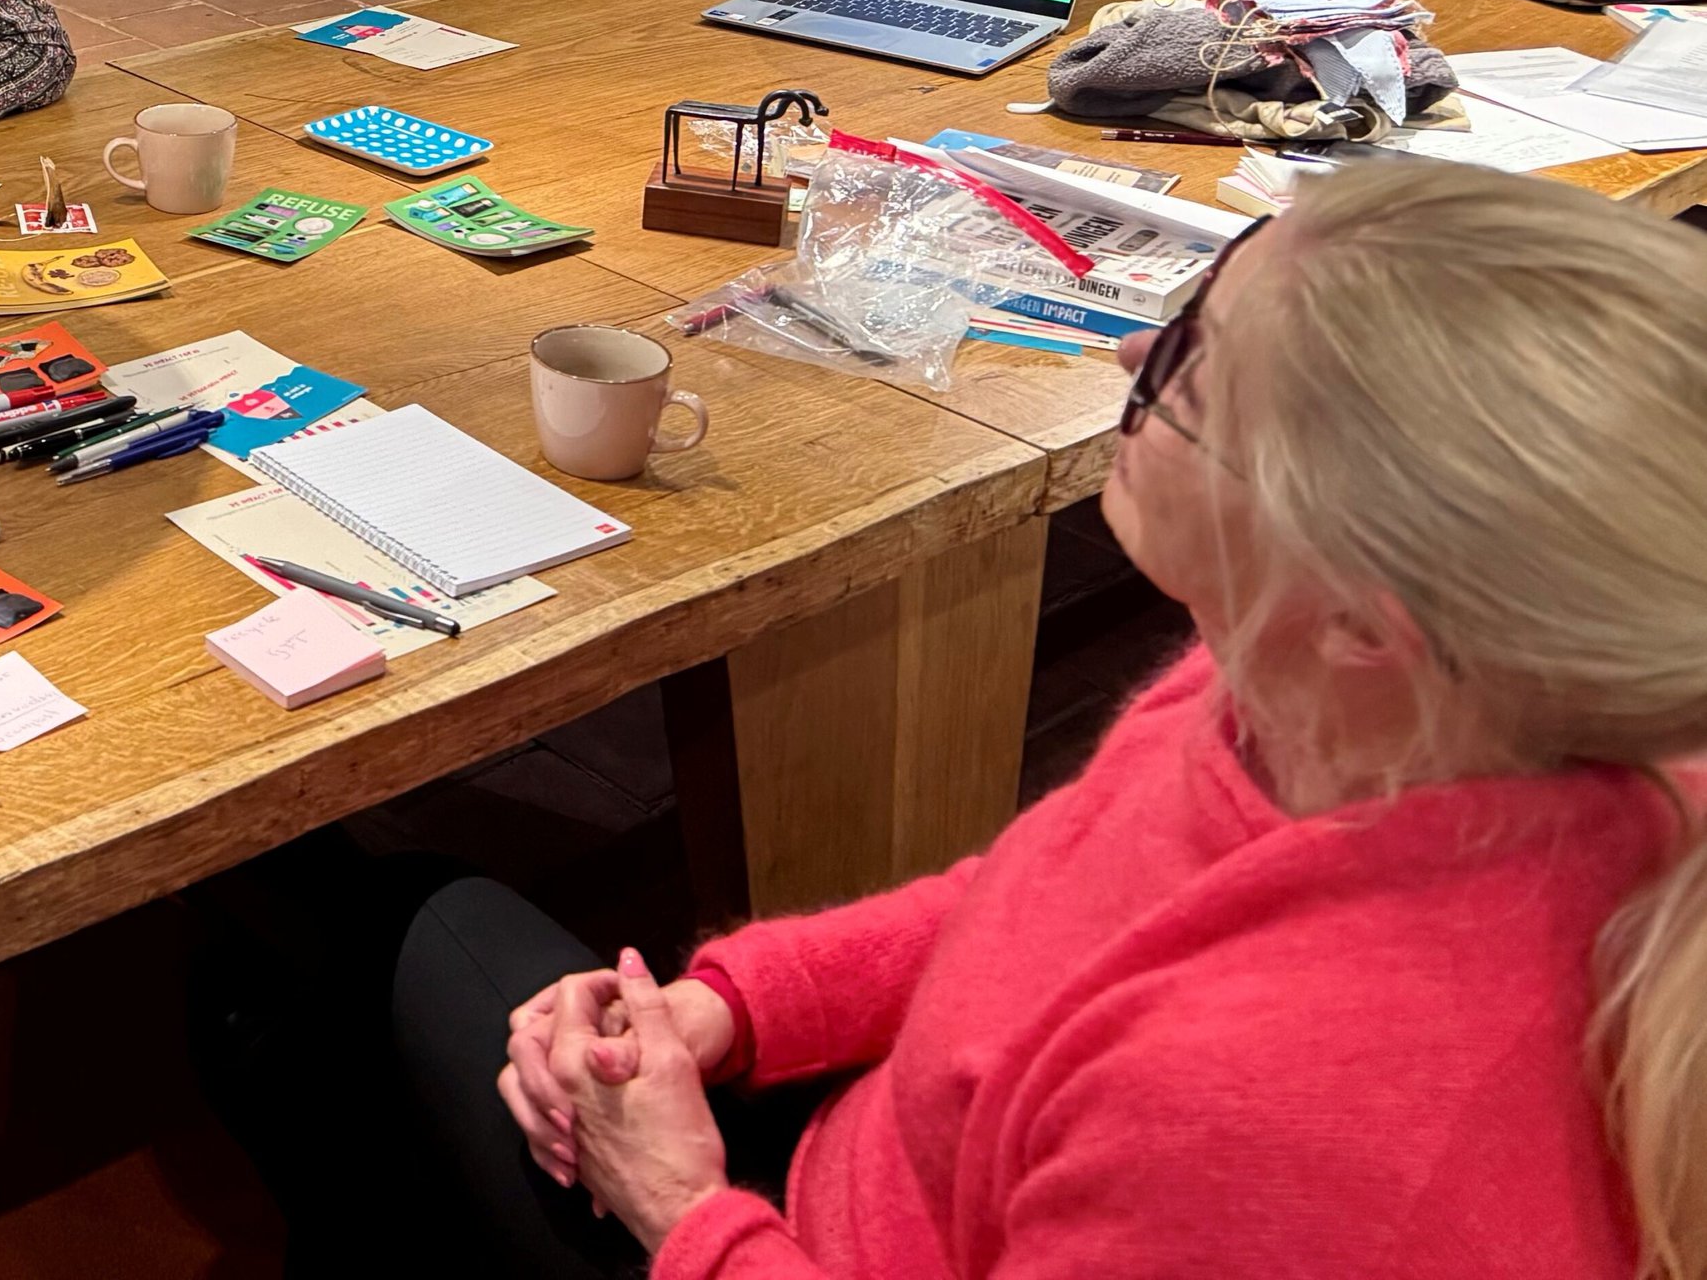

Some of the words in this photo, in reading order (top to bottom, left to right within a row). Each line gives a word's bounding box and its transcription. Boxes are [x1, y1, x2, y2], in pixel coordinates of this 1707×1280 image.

[264, 193, 357, 221] REFUSE
[1078, 279, 1121, 301] DINGEN
[1043, 303, 1088, 325] IMPACT
[241, 492, 268, 505] IMPACT
